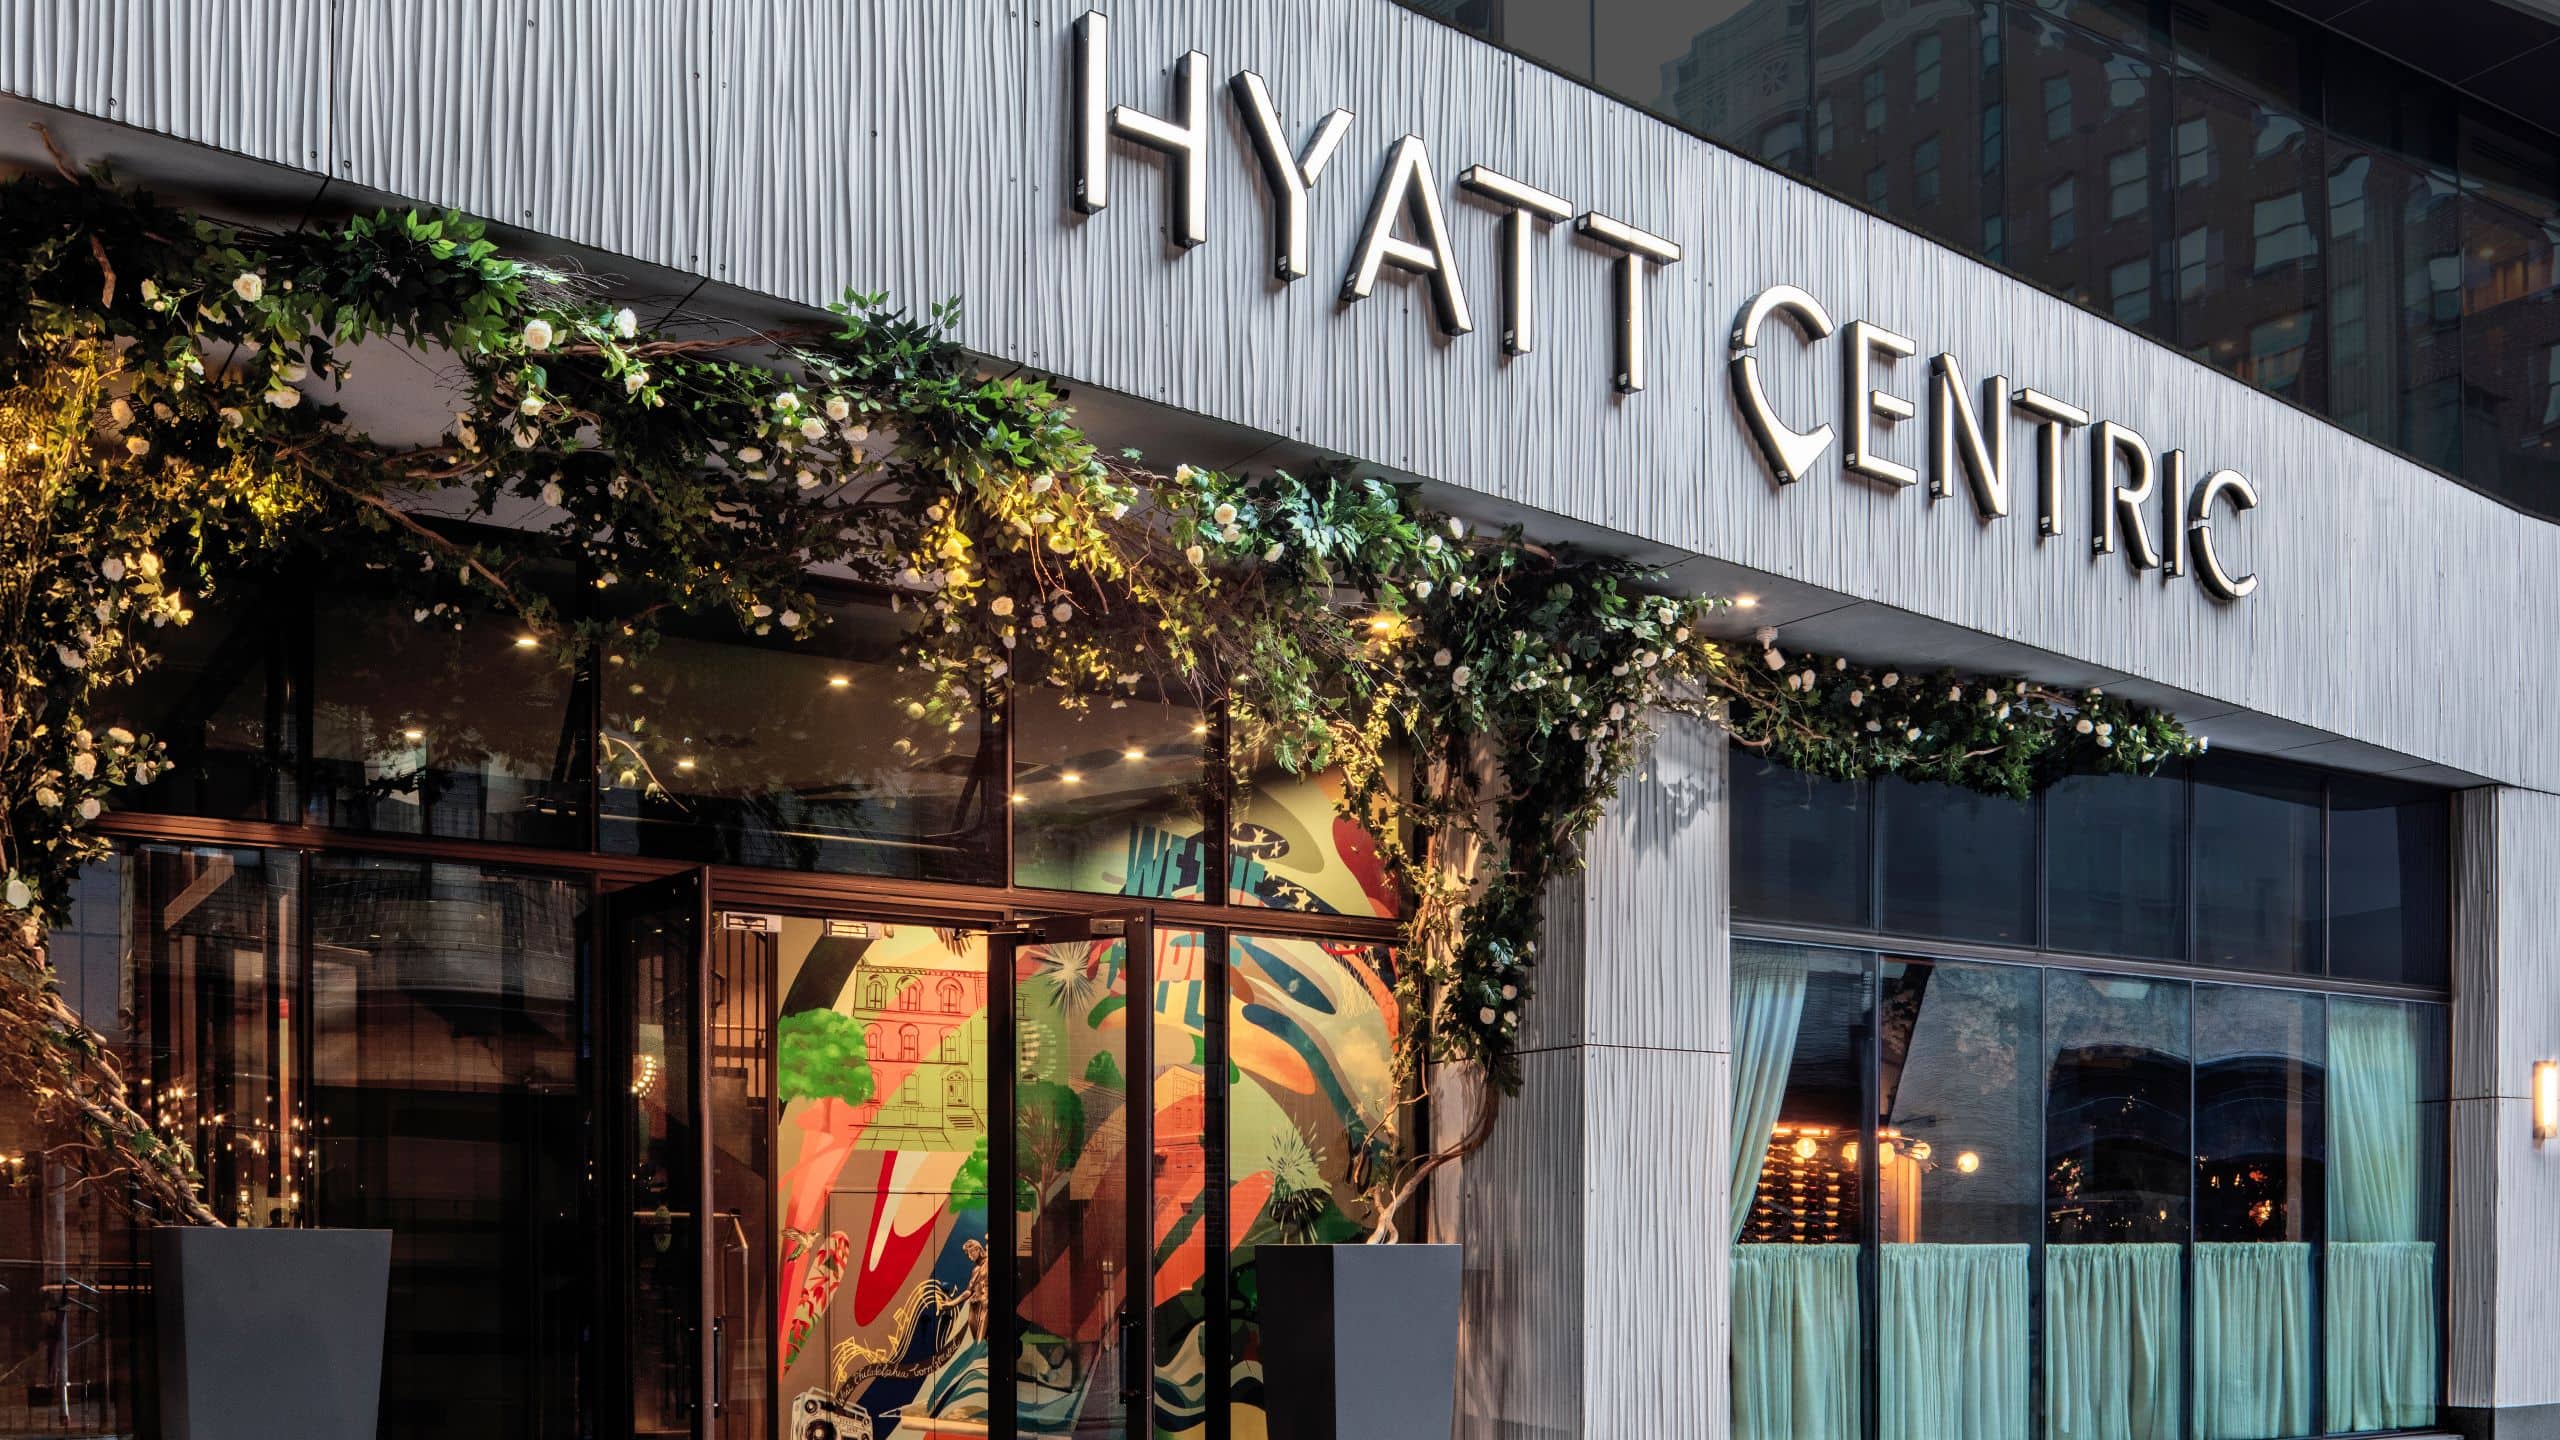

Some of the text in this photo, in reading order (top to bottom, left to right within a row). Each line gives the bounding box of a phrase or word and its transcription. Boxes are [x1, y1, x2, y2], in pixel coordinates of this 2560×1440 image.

[1072, 9, 2259, 601] HYATT CENTRIC
[1126, 822, 1187, 898] WE
